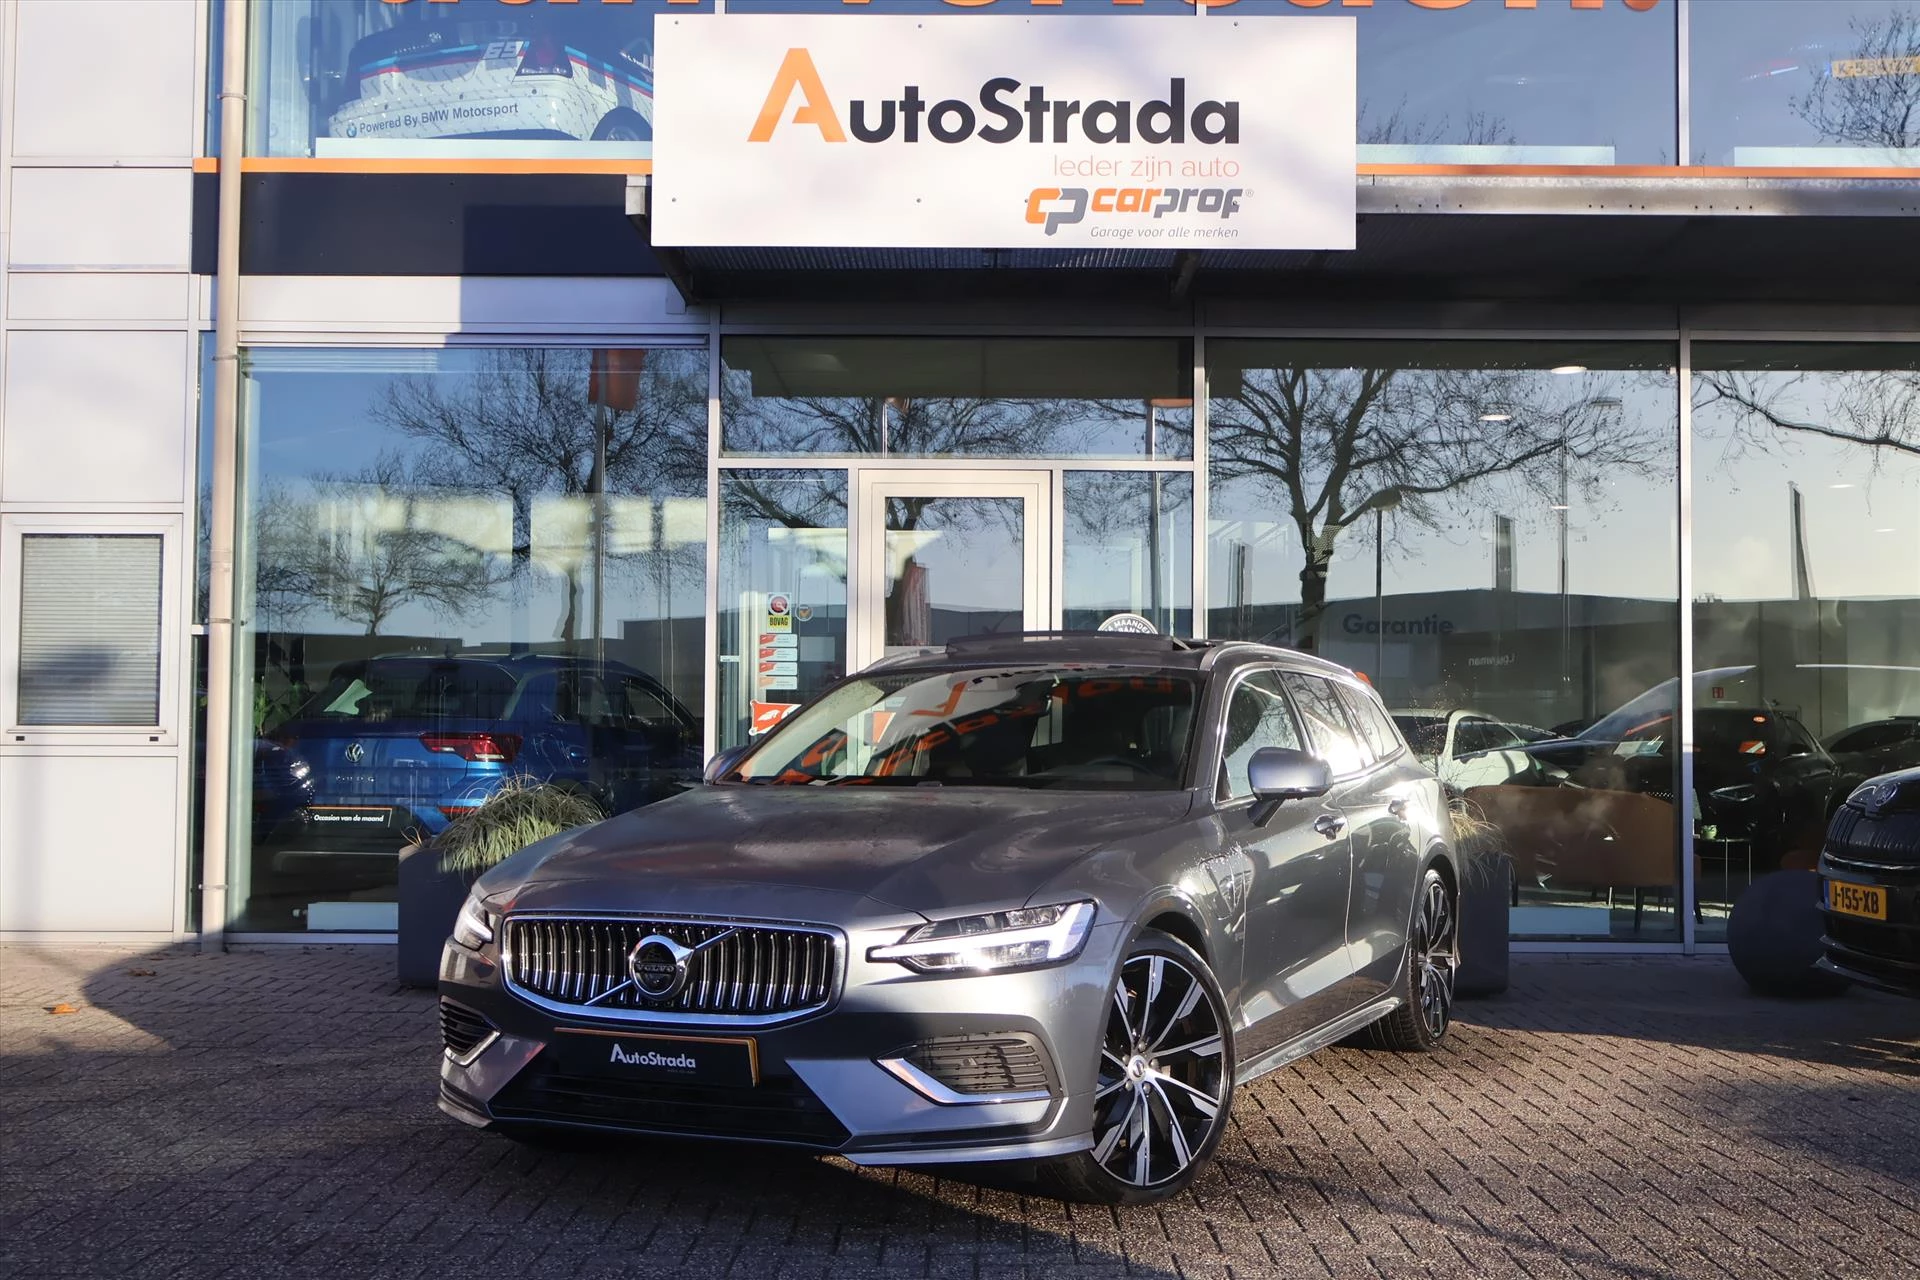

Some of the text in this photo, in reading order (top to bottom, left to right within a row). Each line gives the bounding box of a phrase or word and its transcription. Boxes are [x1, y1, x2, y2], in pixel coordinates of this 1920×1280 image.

[746, 47, 1240, 144] AutoStrada
[359, 102, 519, 134] Powered By BMW Motorsport
[1053, 154, 1240, 183] Ieder zijn auto
[1090, 226, 1239, 240] Garage voor alle merken
[769, 616, 789, 626] BOVAG
[1113, 618, 1151, 633] MAANDE
[1342, 613, 1454, 635] Garantie
[314, 814, 340, 822] Occasion
[353, 814, 361, 822] de
[362, 814, 384, 822] maand
[1832, 885, 1880, 914] J-155-XB
[635, 963, 675, 973] VOLVO
[610, 1043, 697, 1068] AutoStrada
